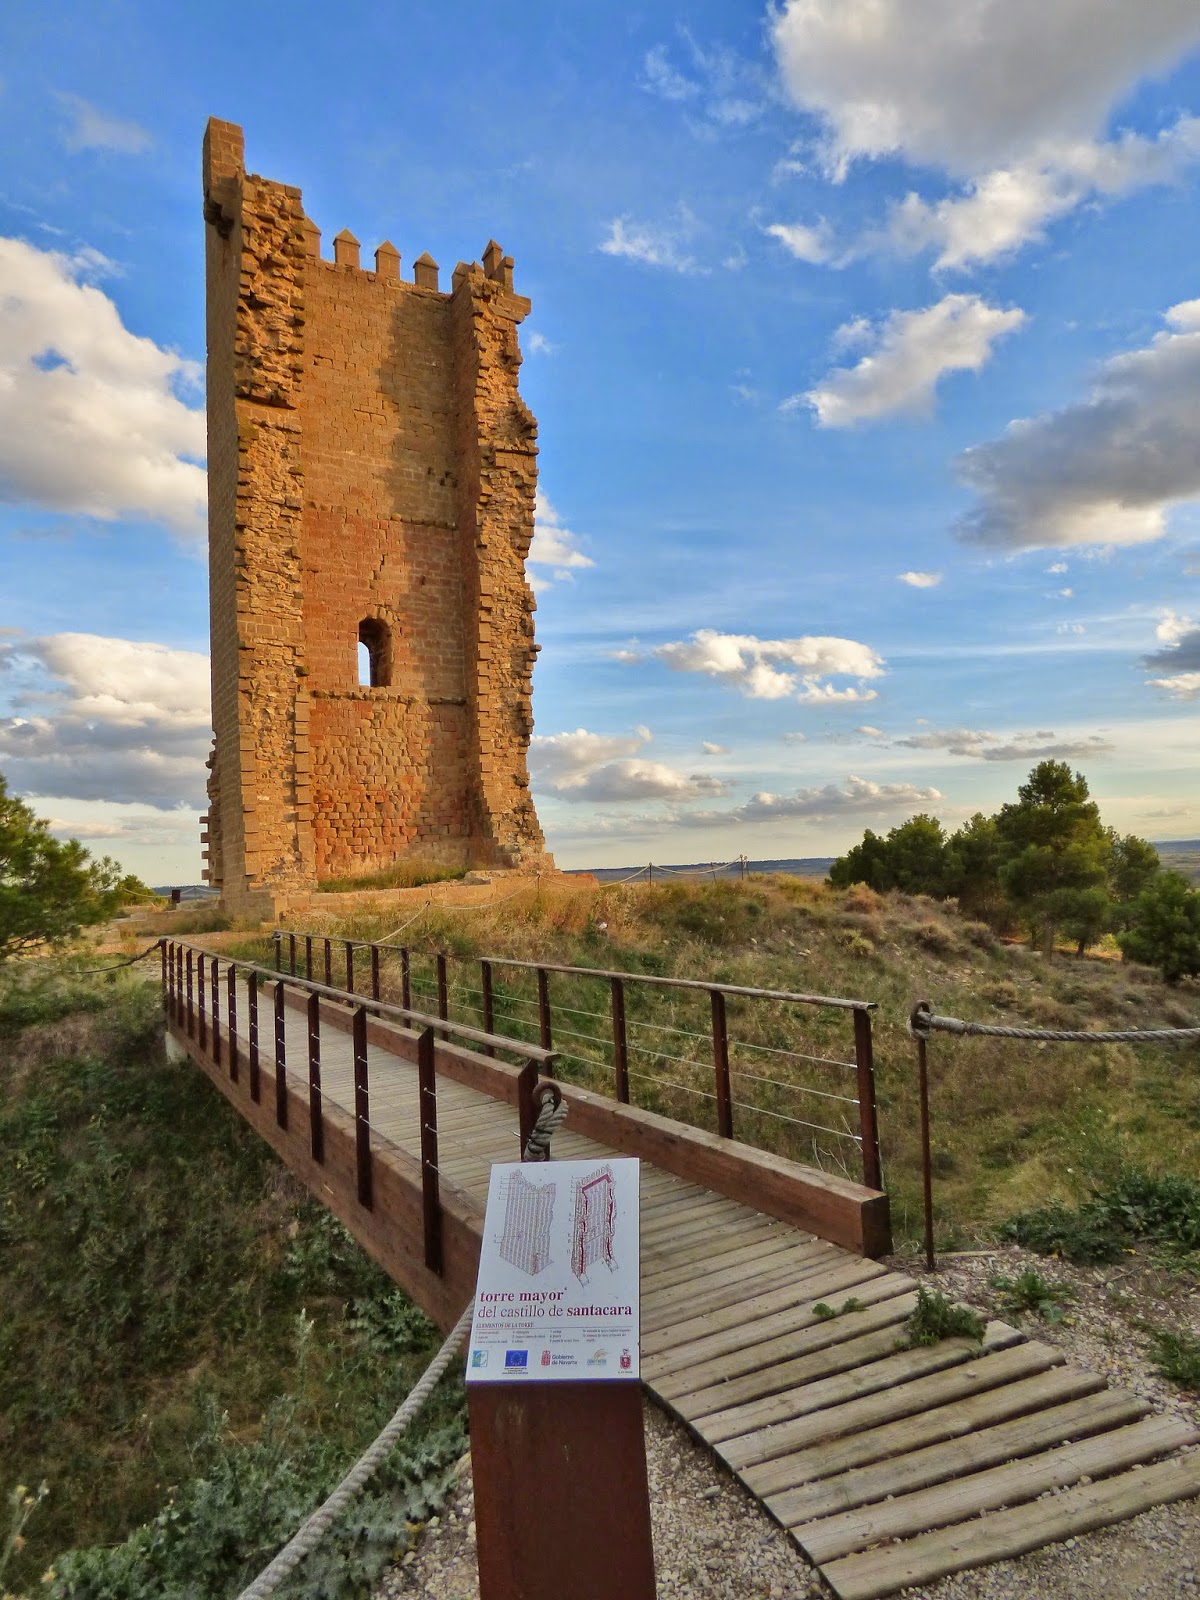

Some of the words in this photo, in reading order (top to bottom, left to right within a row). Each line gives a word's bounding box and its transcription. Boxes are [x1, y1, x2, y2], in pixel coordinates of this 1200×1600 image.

[480, 1291, 515, 1302] torre
[519, 1291, 564, 1304] mayor
[478, 1306, 496, 1318] del
[500, 1305, 545, 1318] castillo
[548, 1305, 563, 1317] de
[567, 1304, 632, 1317] santacara
